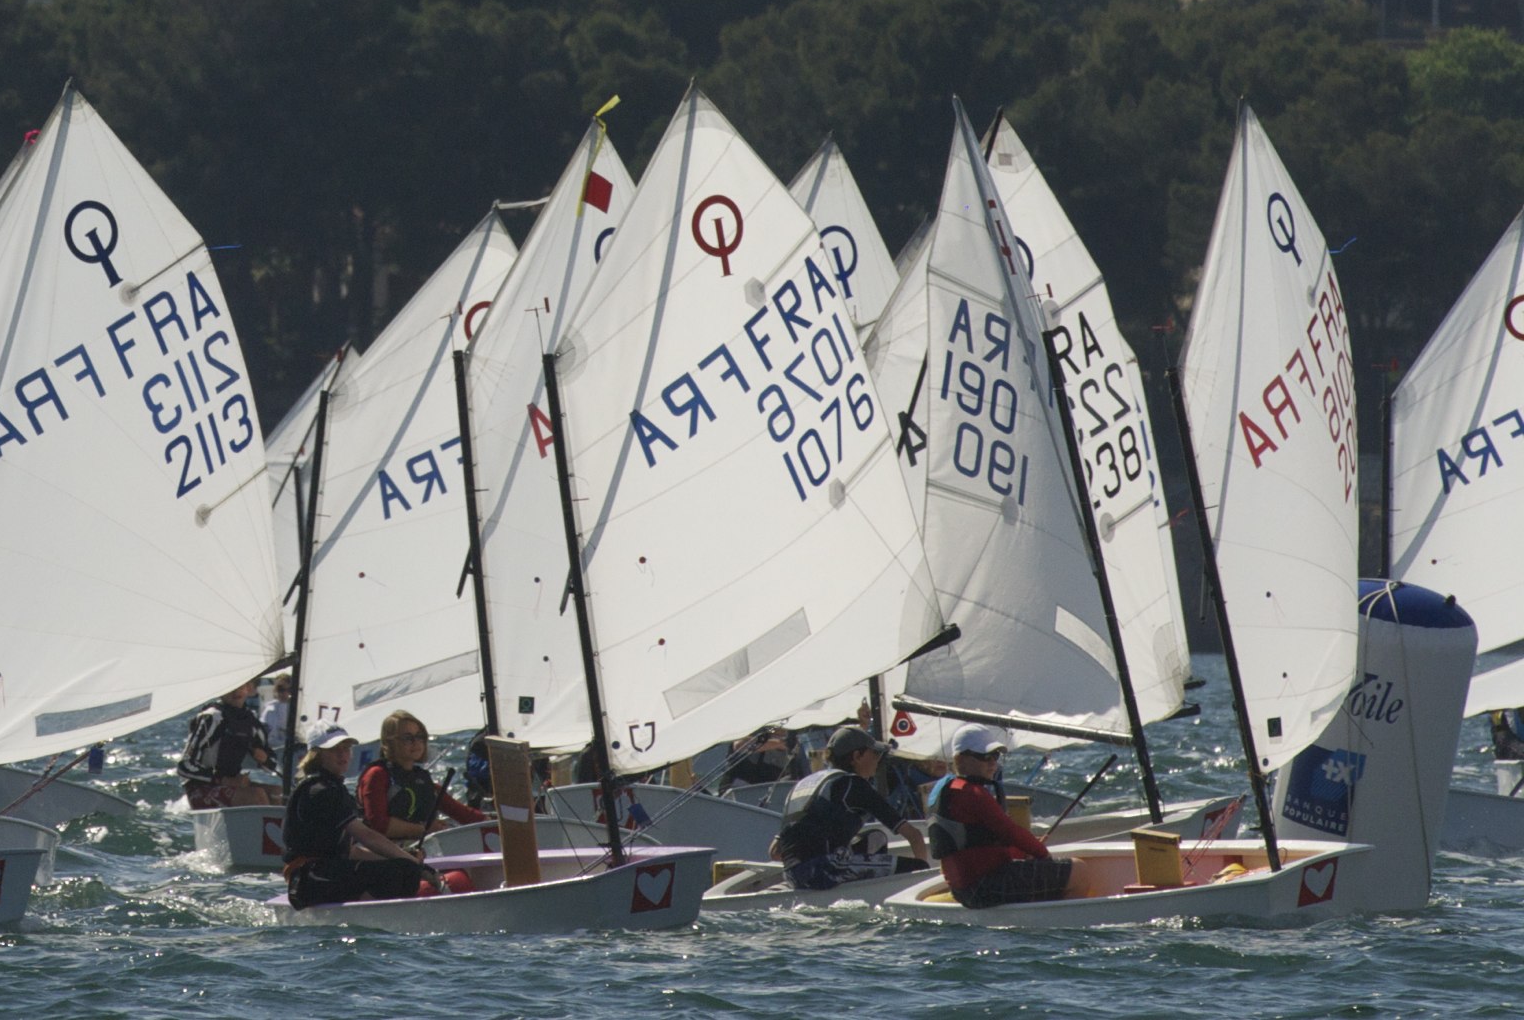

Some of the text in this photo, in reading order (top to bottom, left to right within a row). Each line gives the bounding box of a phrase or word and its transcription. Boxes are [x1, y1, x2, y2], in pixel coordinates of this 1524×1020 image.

[106, 271, 220, 380] FRA
[743, 256, 836, 372] FRA
[1053, 311, 1104, 383] RA
[1307, 271, 1344, 378] FRA
[165, 394, 253, 499] 2113
[782, 372, 874, 503] 1076
[1284, 805, 1344, 832] POPULAIRE
[1287, 793, 1348, 820] BANQUE
